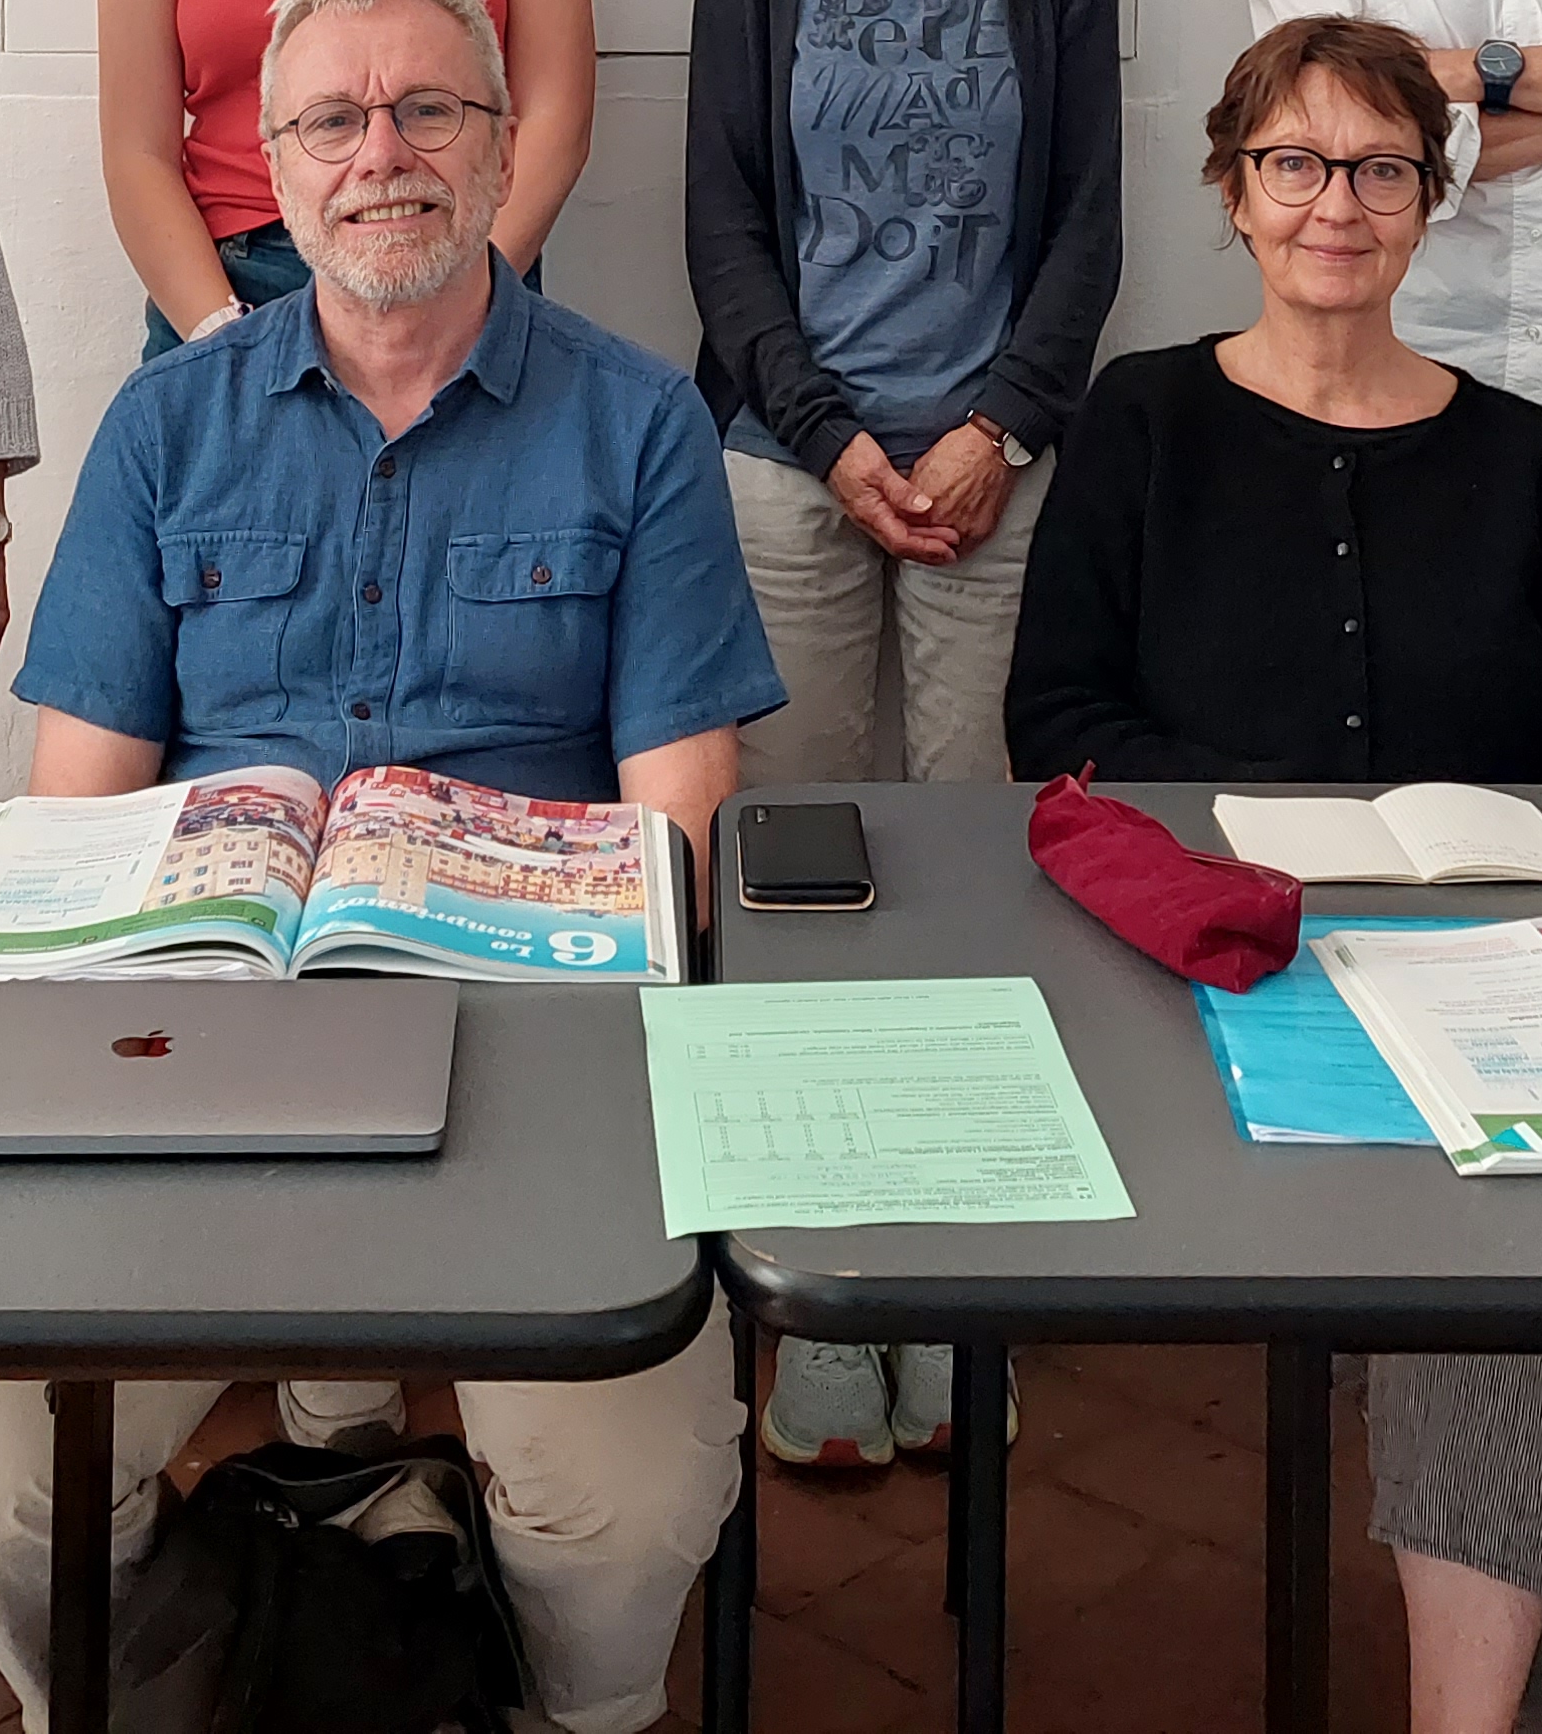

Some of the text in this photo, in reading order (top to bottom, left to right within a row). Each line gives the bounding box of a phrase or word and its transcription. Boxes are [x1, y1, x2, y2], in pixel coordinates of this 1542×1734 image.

[327, 896, 533, 941] compriamo?
[490, 940, 535, 958] Lo
[548, 930, 617, 966] 6
